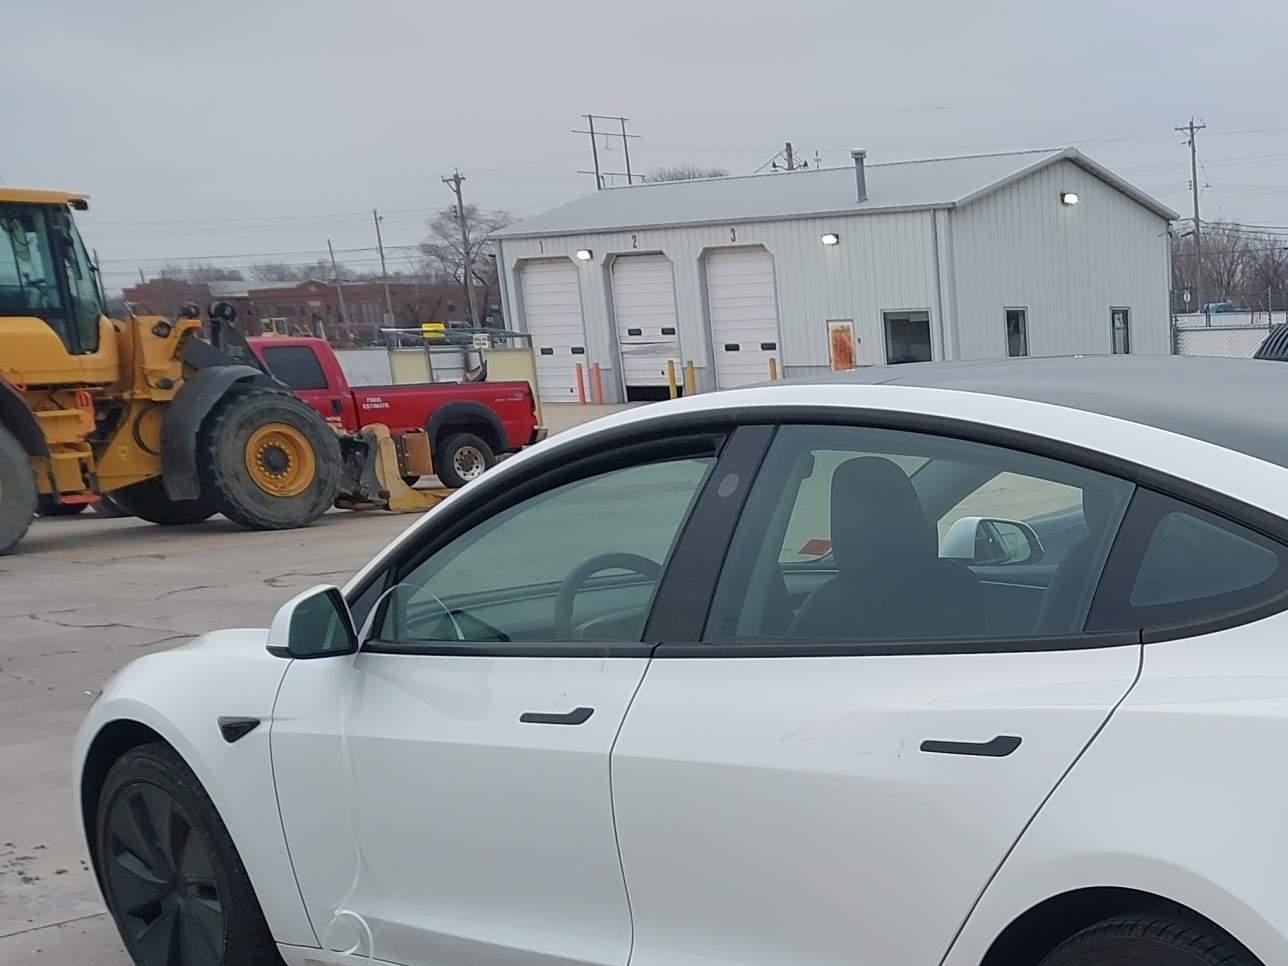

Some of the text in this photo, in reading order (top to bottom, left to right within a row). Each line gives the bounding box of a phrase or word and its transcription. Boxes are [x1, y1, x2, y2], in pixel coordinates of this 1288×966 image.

[632, 235, 638, 248] 2
[730, 228, 736, 242] 3
[539, 241, 544, 254] 1
